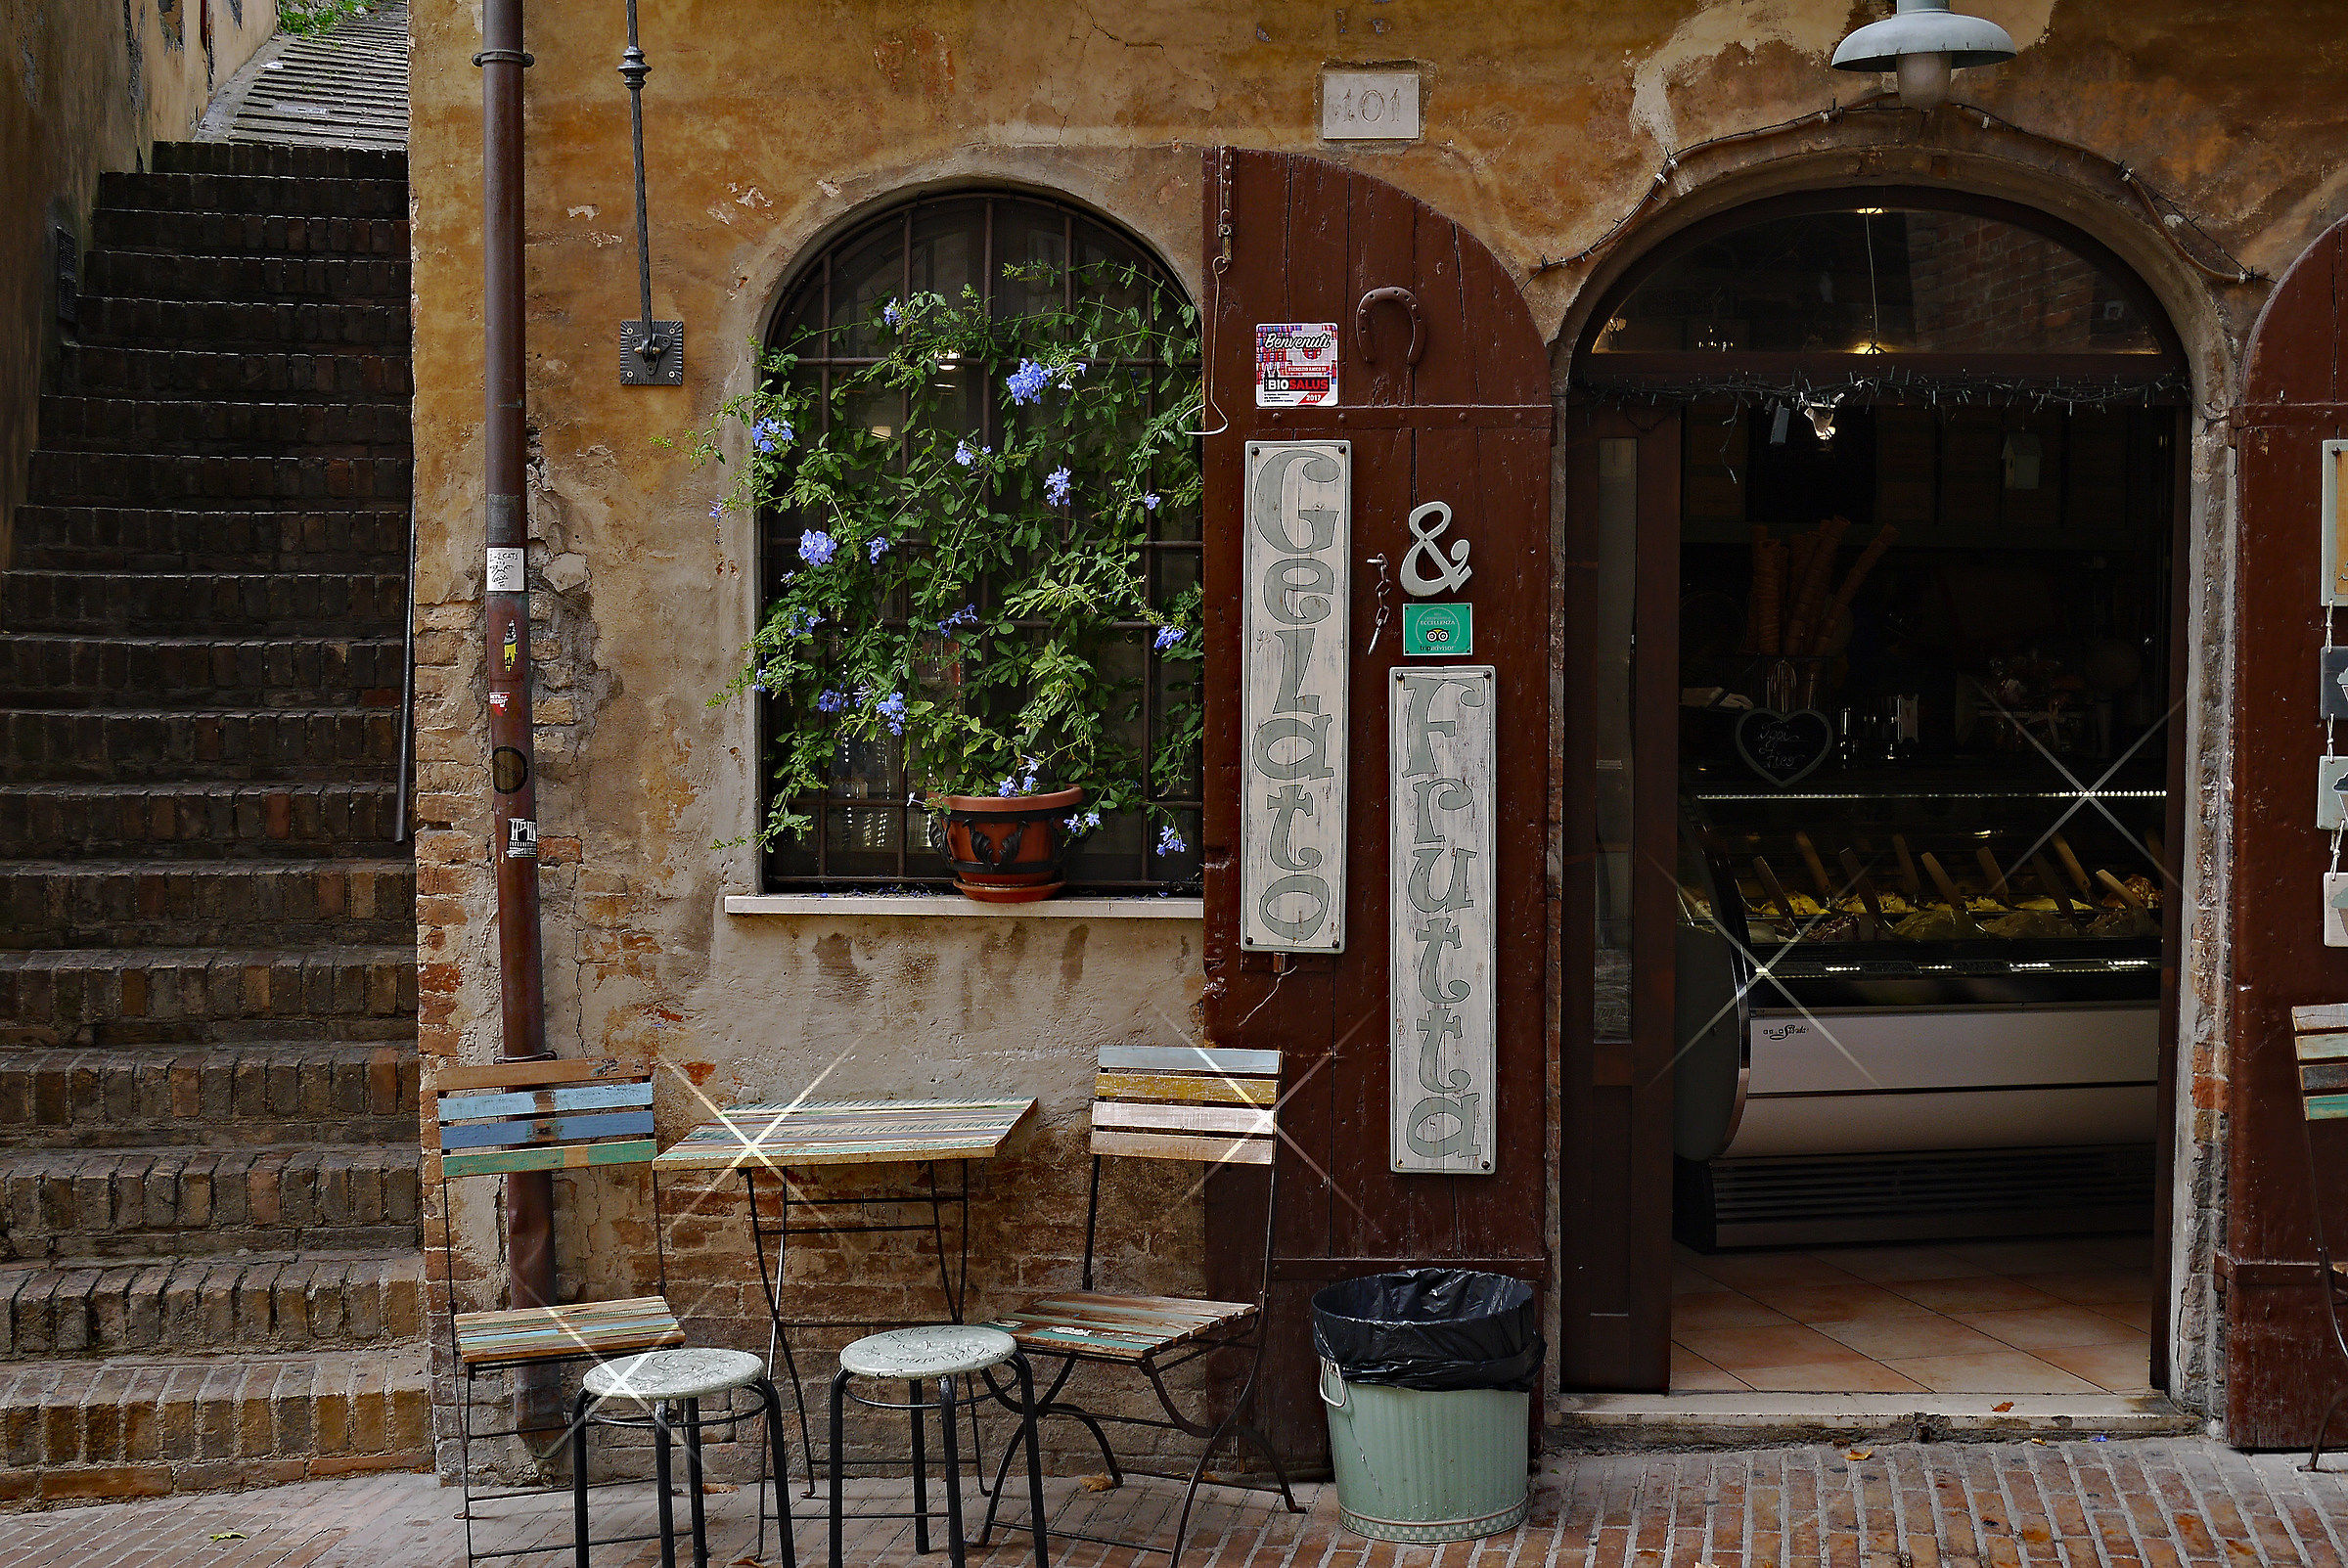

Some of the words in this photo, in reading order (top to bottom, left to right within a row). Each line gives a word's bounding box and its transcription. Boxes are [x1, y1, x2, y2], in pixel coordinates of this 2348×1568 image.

[1341, 88, 1400, 123] 101
[1265, 333, 1331, 349] Benvenuti
[1268, 379, 1329, 390] BIOSALUS
[1400, 501, 1472, 597] &
[1420, 644, 1455, 652] tripadvisor
[1401, 676, 1487, 1158] Frutta
